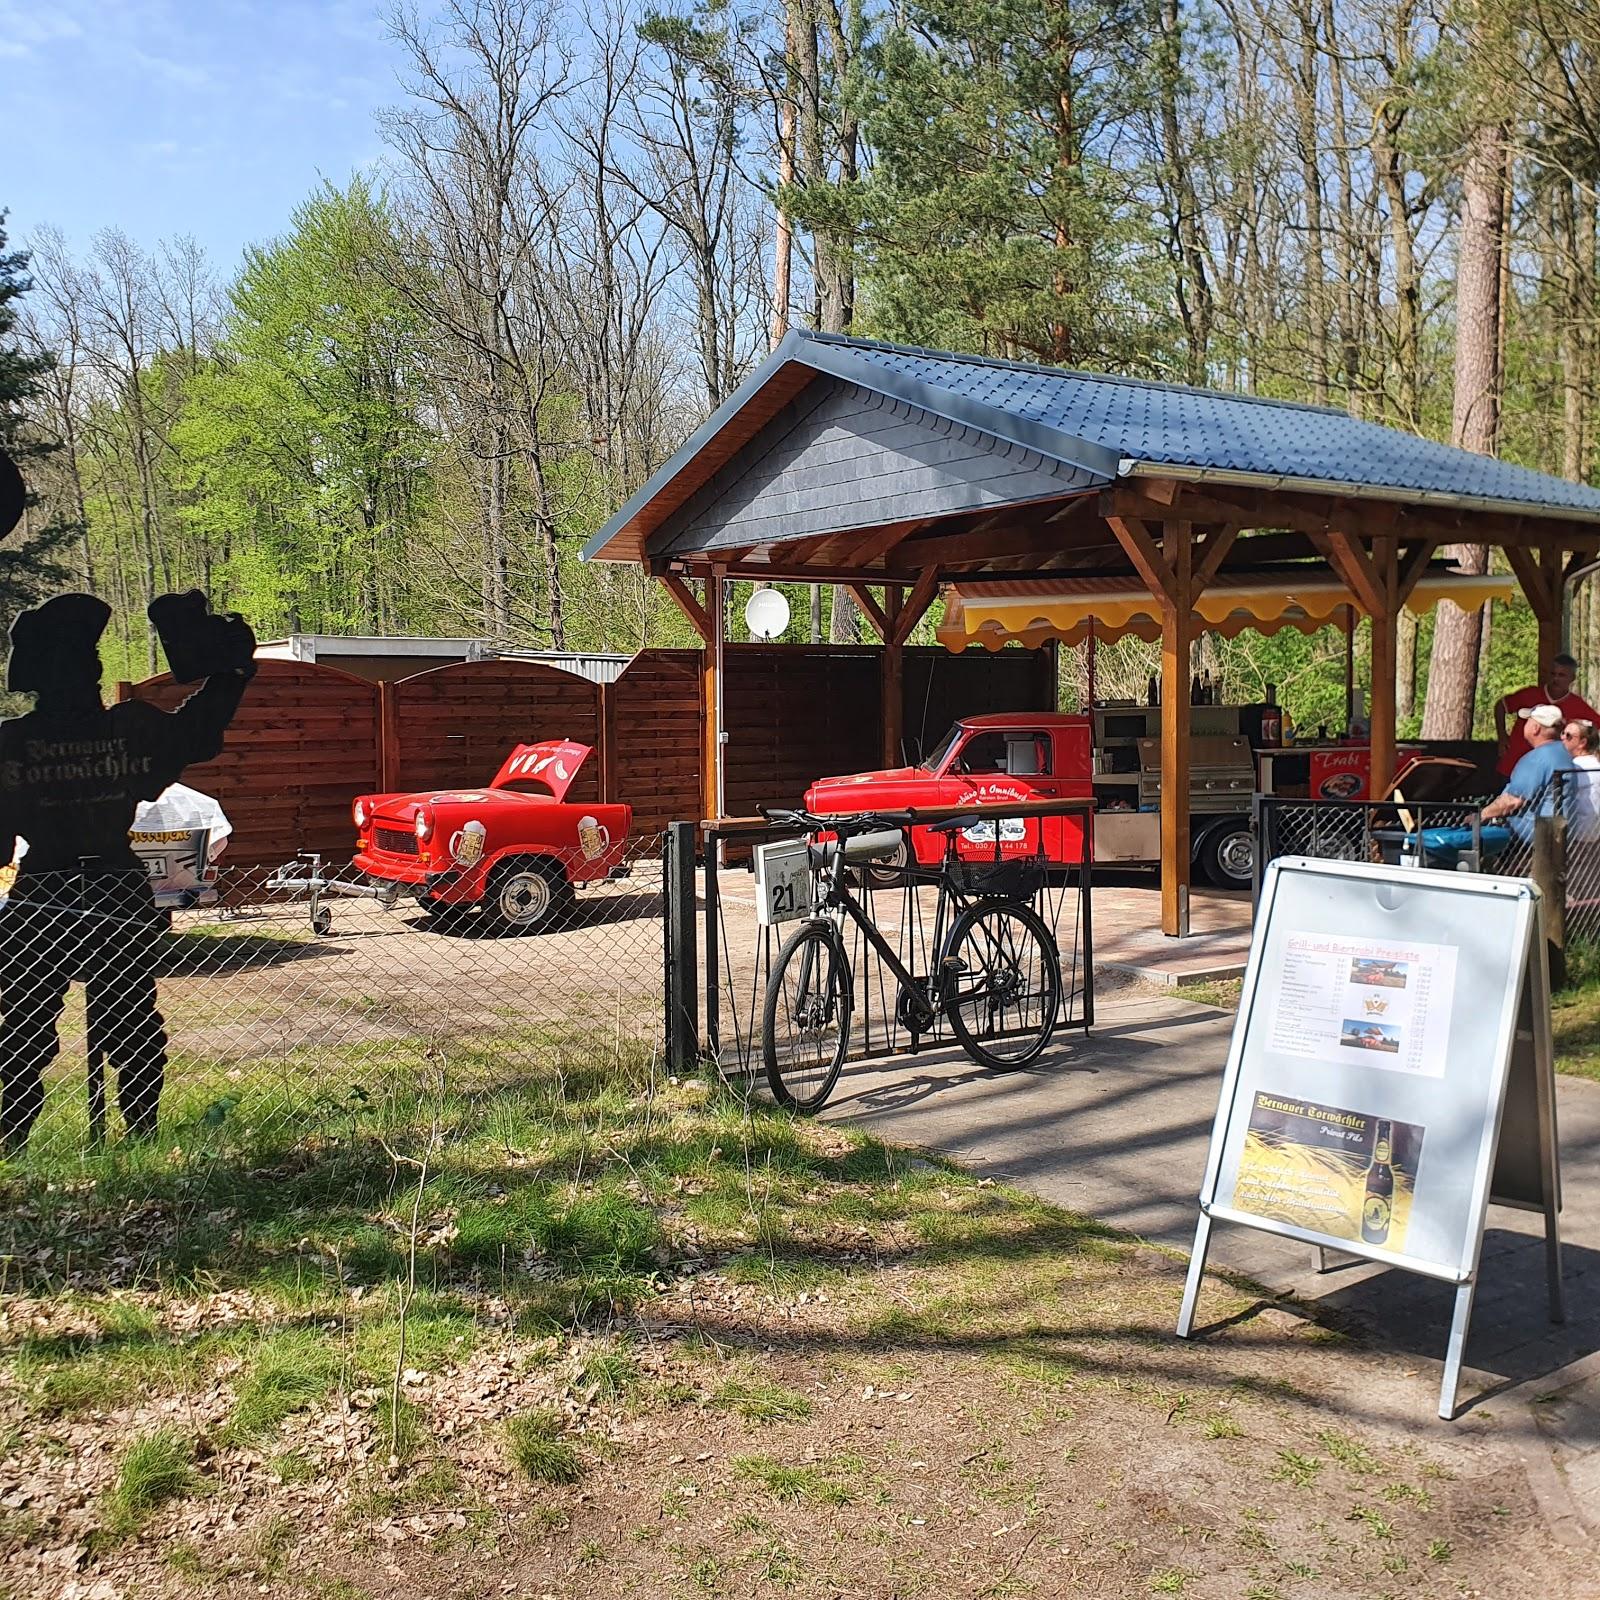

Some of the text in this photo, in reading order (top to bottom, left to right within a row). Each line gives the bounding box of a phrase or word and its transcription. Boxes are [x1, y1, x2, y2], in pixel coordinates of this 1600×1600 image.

[26, 738, 127, 761] Bernauer
[3, 752, 152, 787] Torwächter
[1315, 752, 1359, 768] Trabi
[979, 786, 987, 796] &
[772, 883, 795, 912] 21
[1313, 941, 1330, 951] und
[1257, 1095, 1366, 1128] Bernauer Torwächter
[1346, 1131, 1364, 1143] Pils
